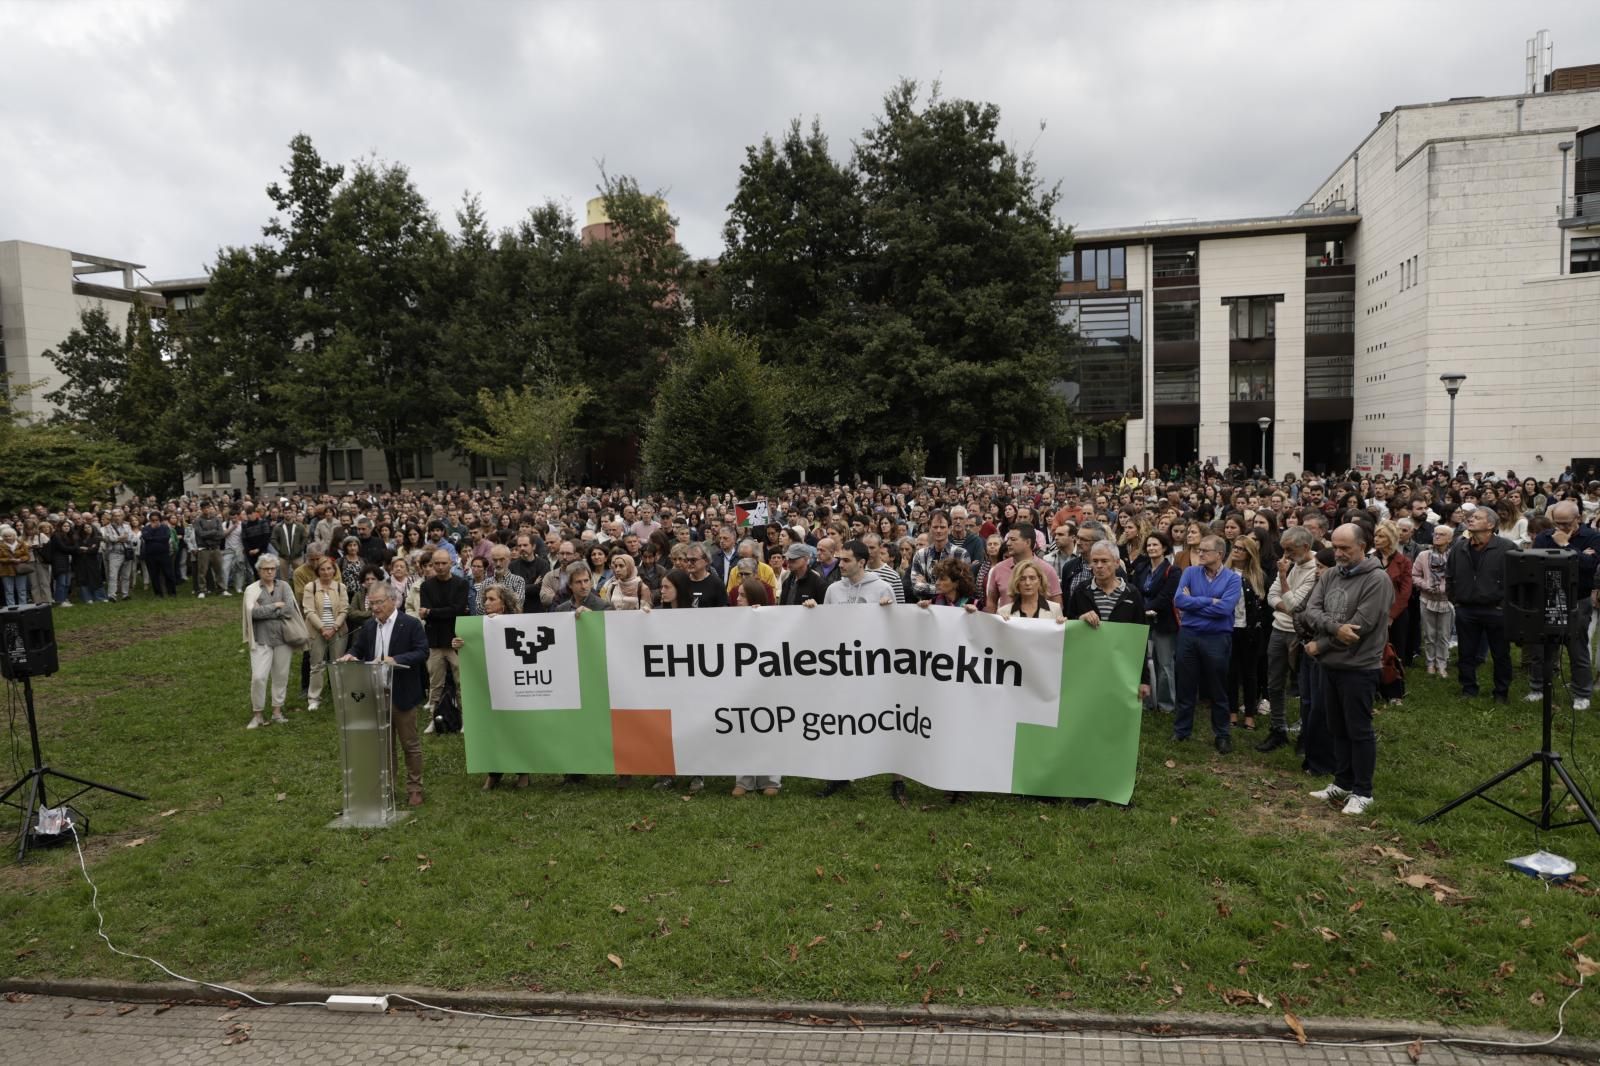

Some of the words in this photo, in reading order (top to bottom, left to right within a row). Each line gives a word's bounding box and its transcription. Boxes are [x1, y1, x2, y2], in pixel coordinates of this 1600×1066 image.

[513, 669, 553, 686] EHU
[643, 643, 726, 678] EHU
[735, 639, 1023, 687] Palestinarekin
[714, 705, 796, 735] STOP
[802, 703, 932, 741] genocide
